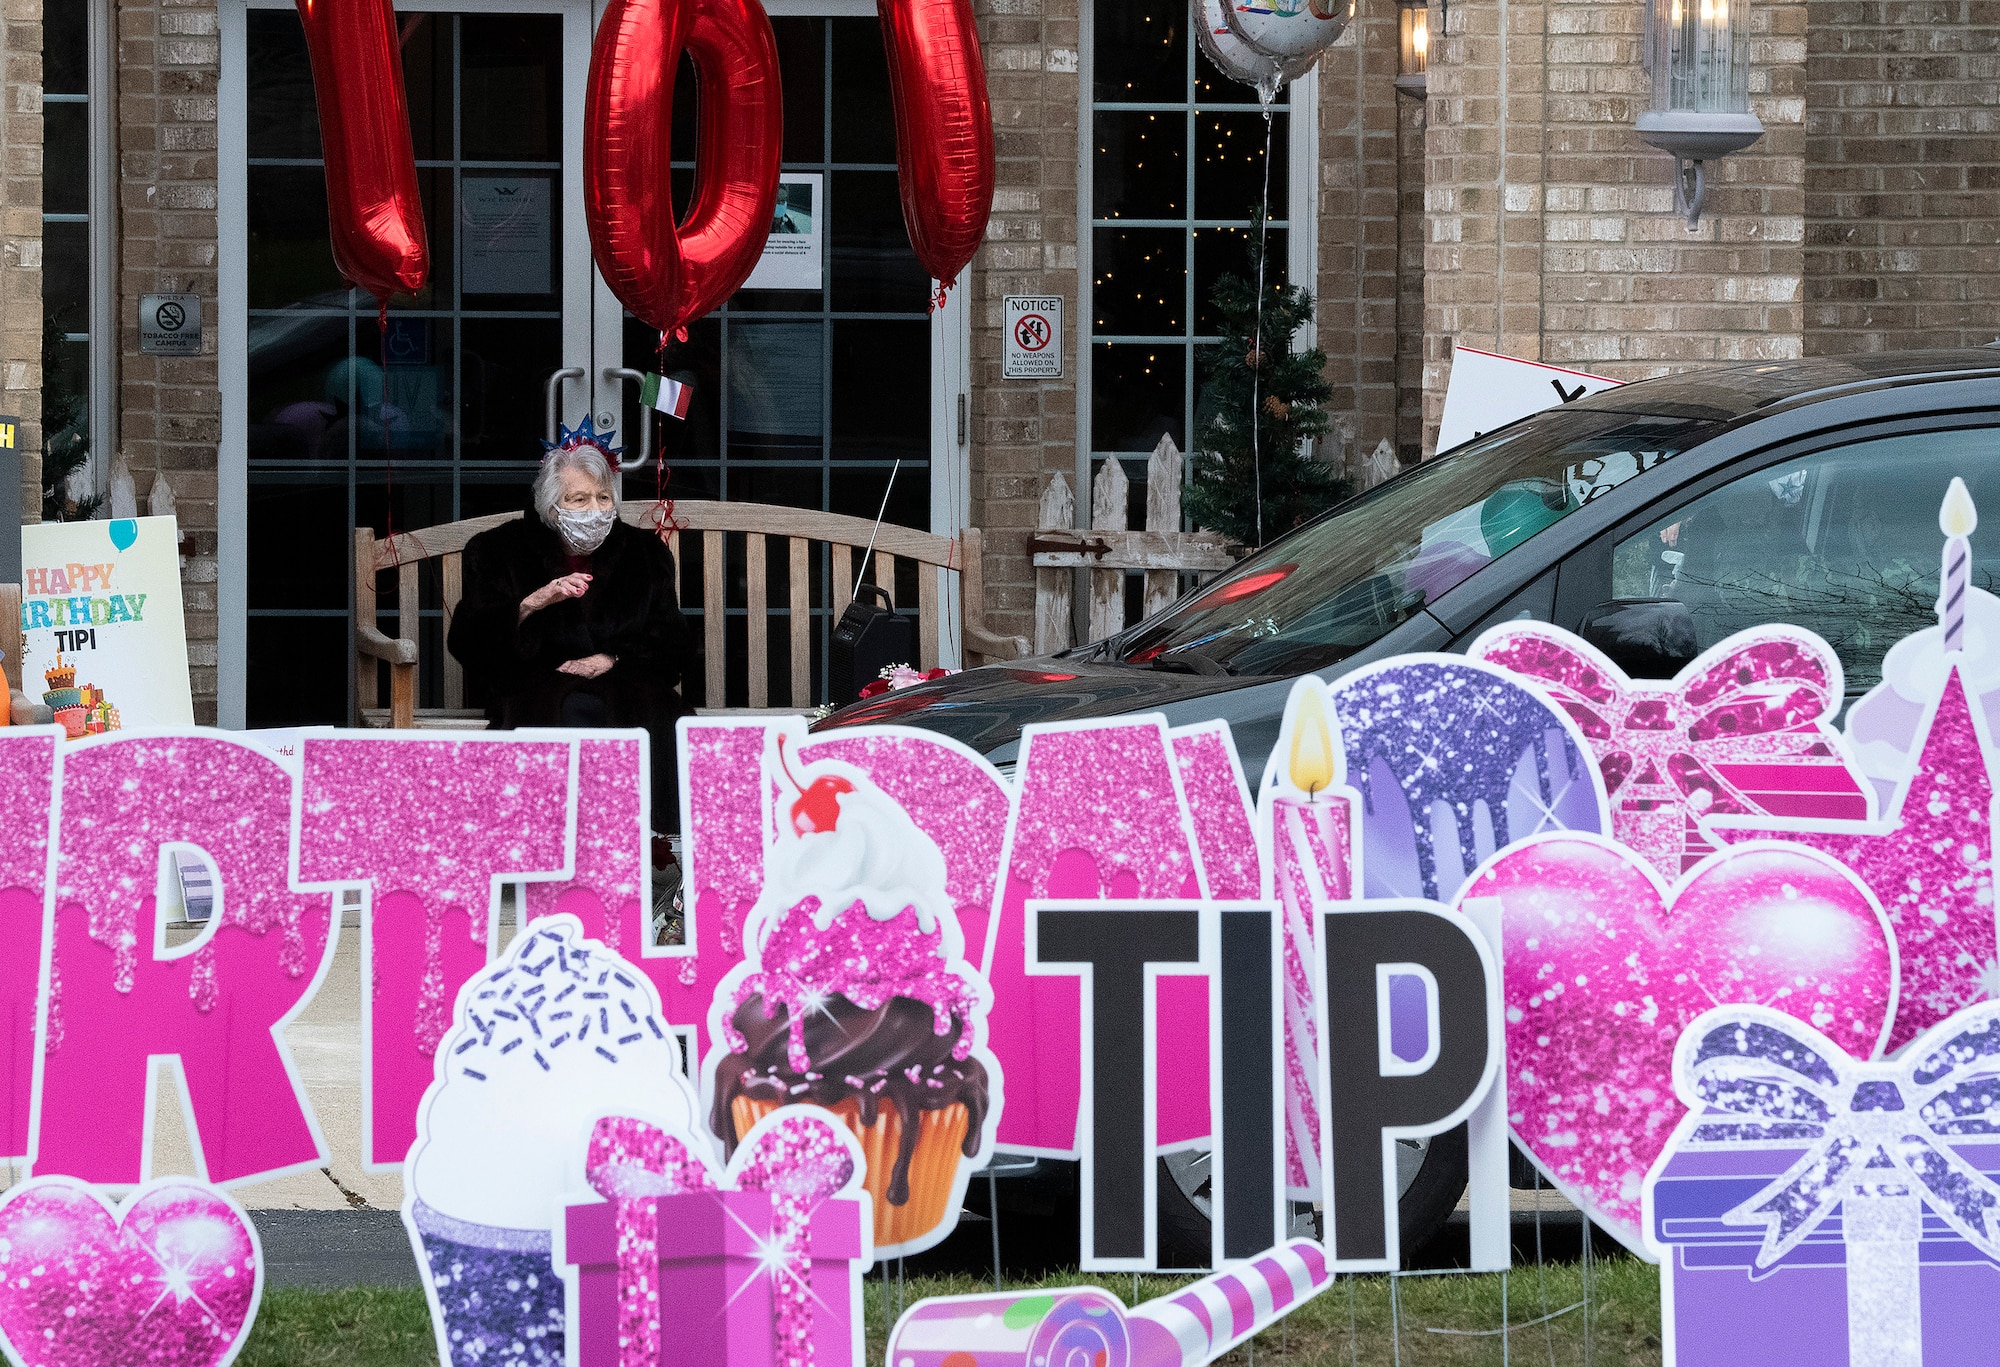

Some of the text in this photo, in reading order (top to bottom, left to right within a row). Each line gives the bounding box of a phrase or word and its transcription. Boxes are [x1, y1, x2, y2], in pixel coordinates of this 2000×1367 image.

[1012, 300, 1056, 311] NOTICE
[25, 562, 115, 595] HAPPY
[53, 628, 97, 652] TIPI
